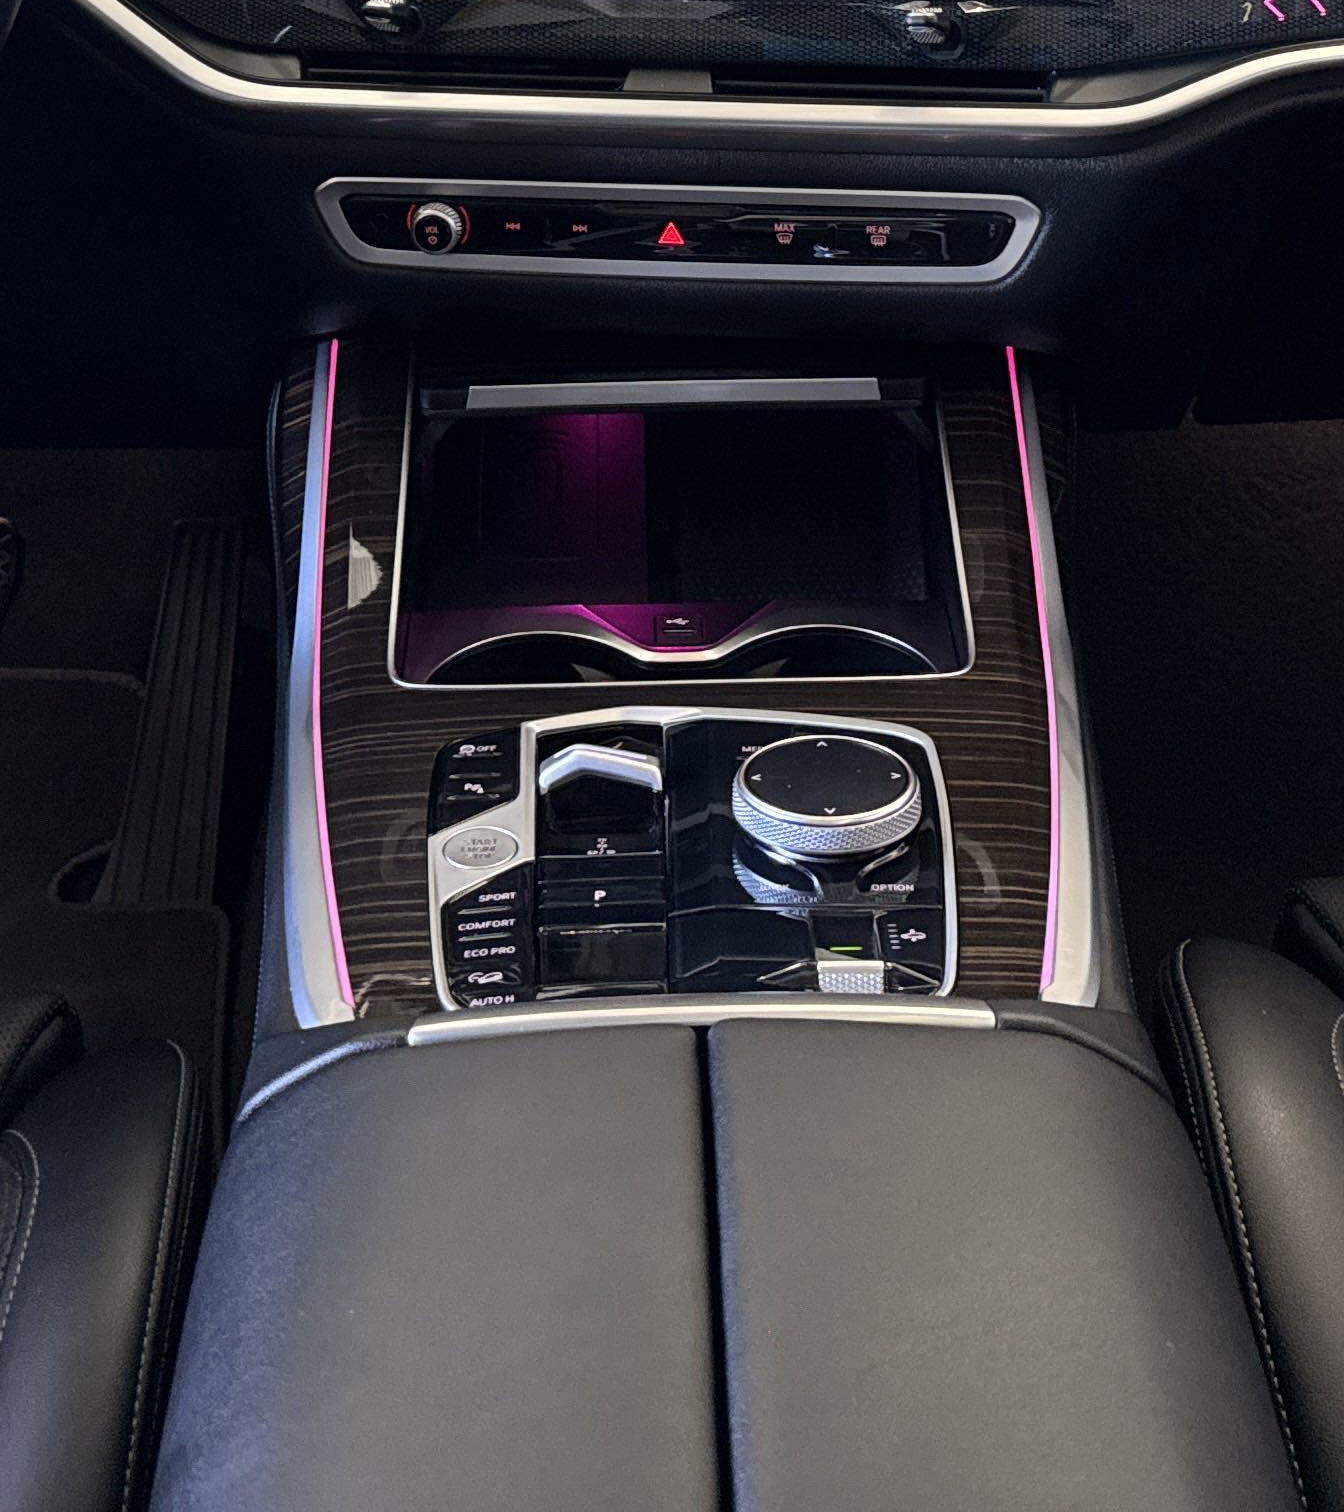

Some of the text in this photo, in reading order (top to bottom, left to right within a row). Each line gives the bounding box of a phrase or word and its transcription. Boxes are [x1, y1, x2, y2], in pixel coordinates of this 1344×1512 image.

[774, 223, 796, 232] MAX
[866, 225, 890, 235] REAR
[476, 744, 497, 753] OFF
[870, 884, 914, 892] OPTION
[478, 892, 517, 903] SPORT
[594, 890, 606, 901] P
[457, 918, 516, 931] COMFORT
[463, 946, 516, 958] ECO PRO
[469, 995, 504, 1007] AUTO
